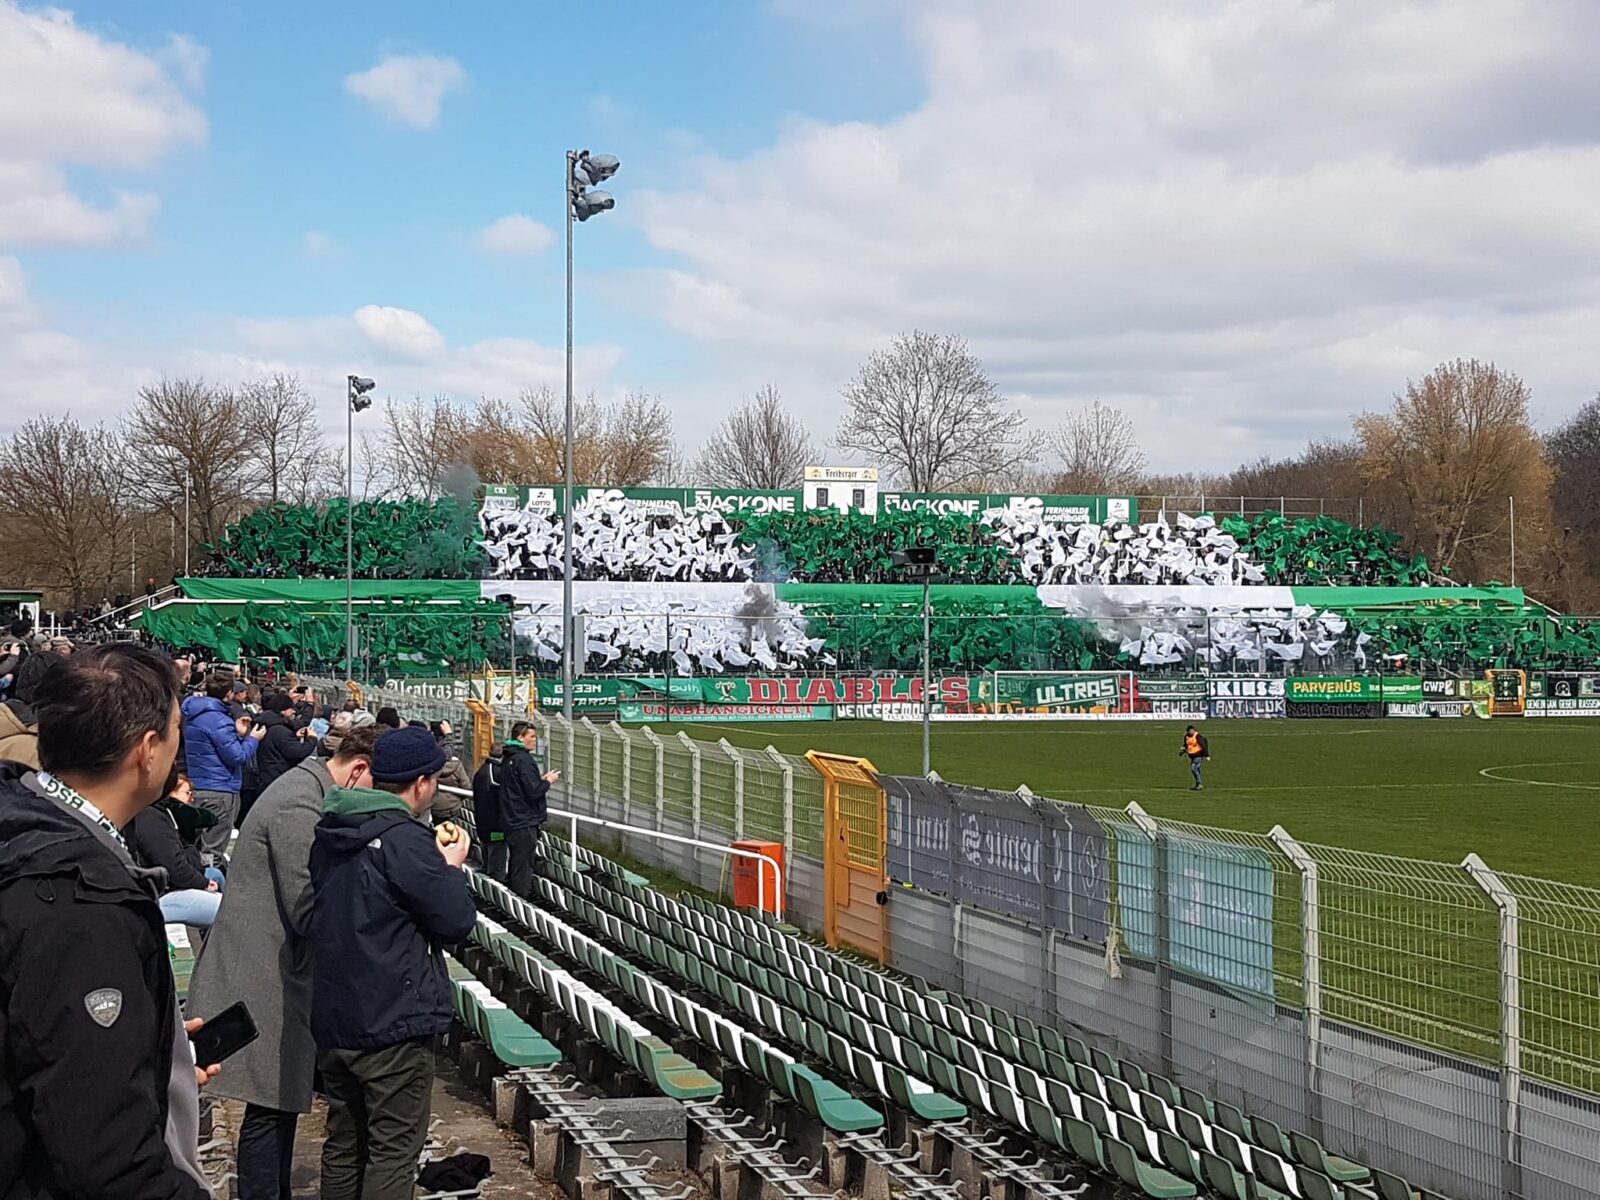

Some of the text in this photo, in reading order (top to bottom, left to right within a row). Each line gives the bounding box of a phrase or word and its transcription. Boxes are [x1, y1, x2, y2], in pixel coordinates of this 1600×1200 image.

[825, 468, 857, 478] Freiberger
[1036, 678, 1115, 704] ULTRAS
[1423, 681, 1445, 693] GWP
[1388, 703, 1416, 714] UMLAND
[46, 779, 85, 809] BSG
